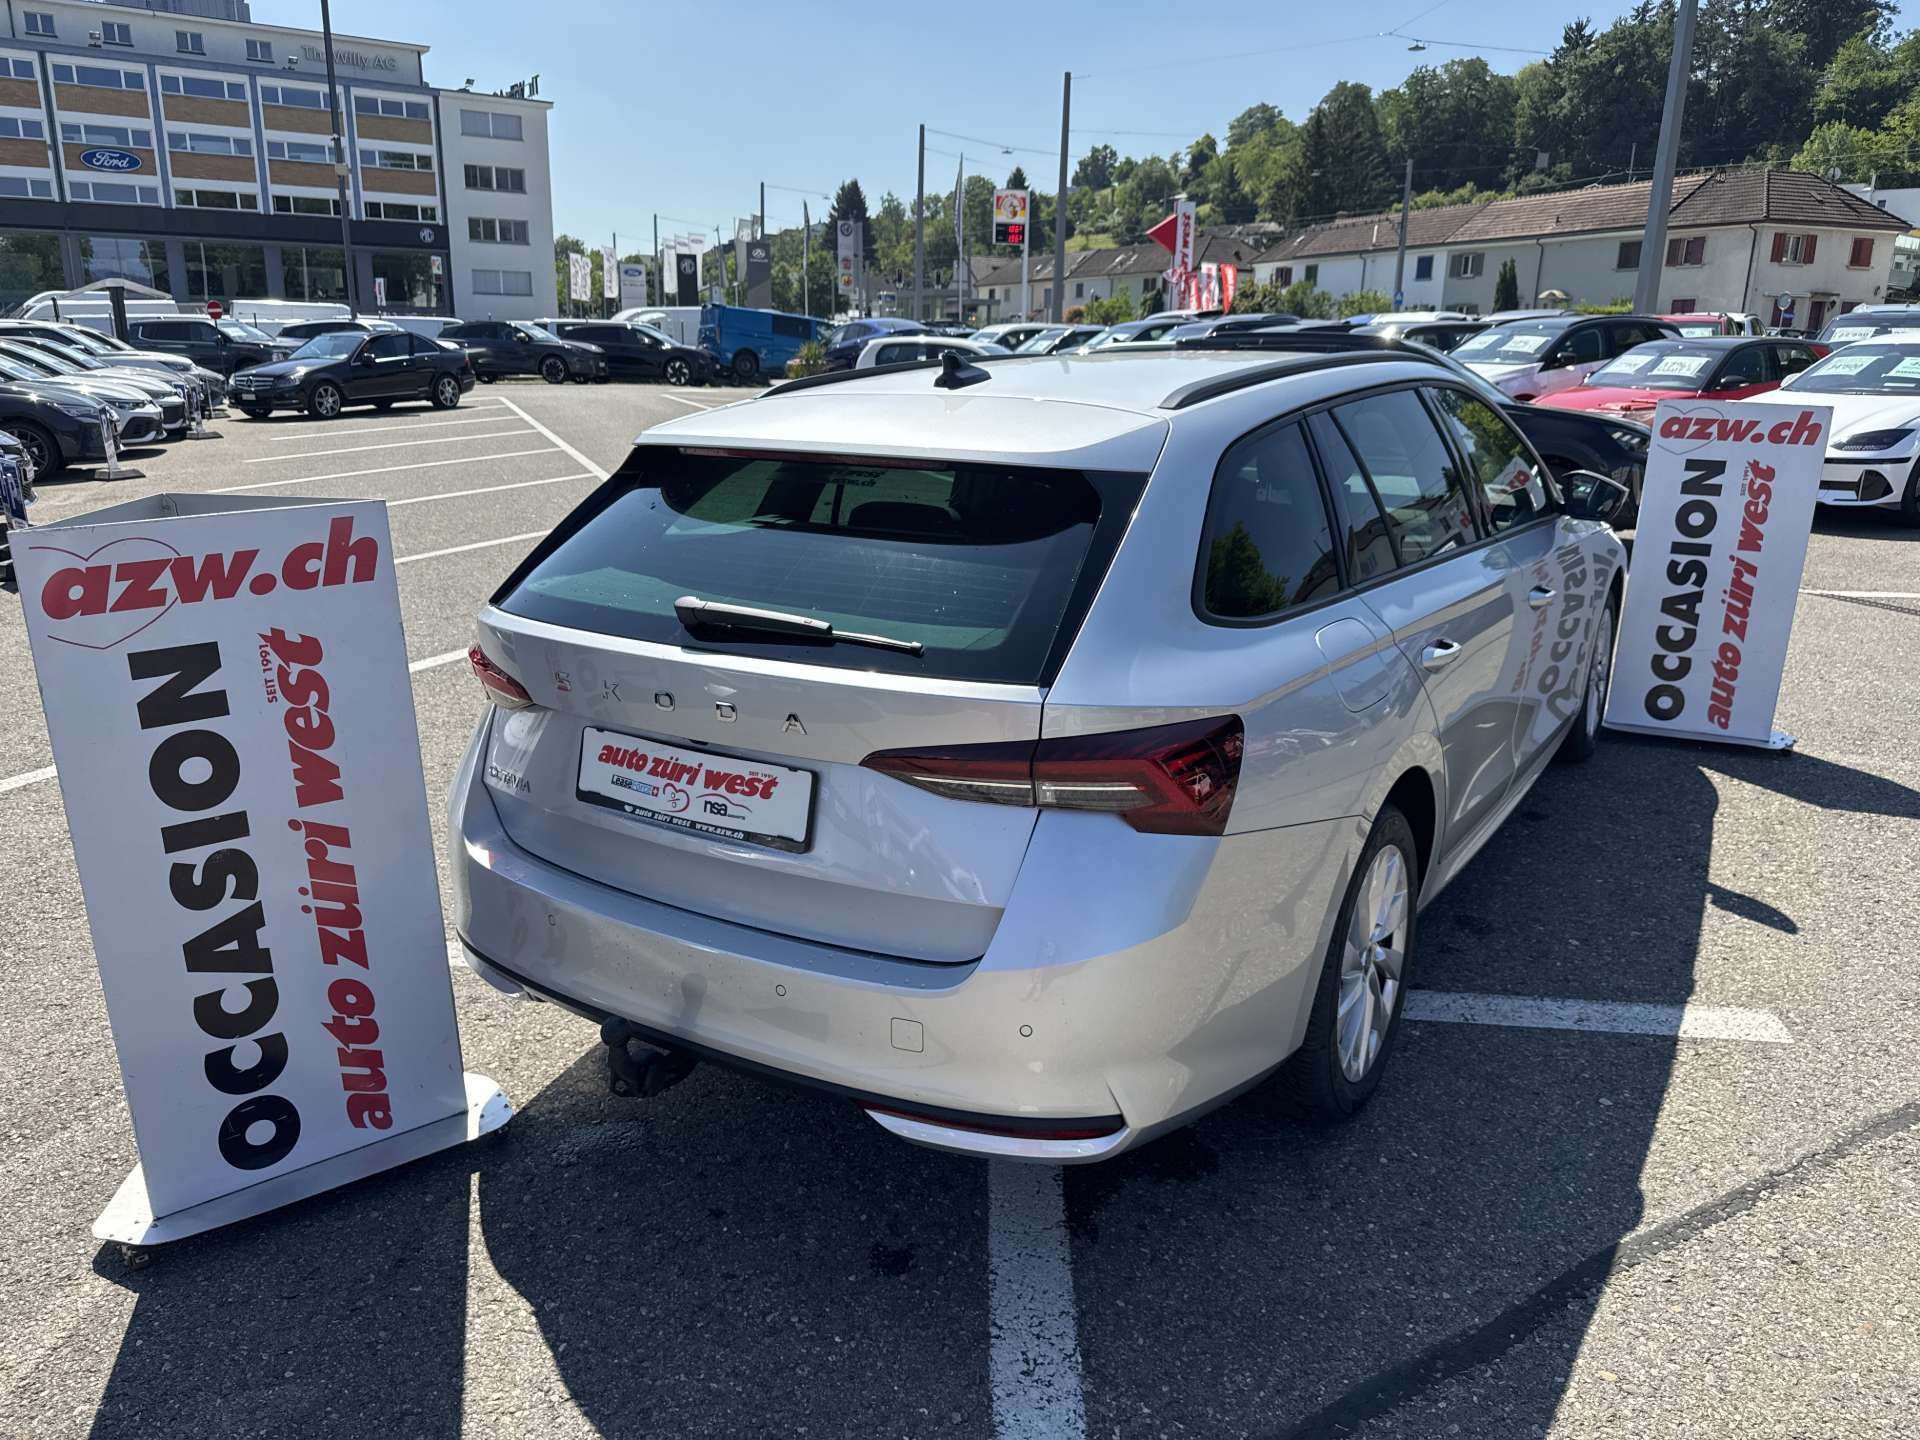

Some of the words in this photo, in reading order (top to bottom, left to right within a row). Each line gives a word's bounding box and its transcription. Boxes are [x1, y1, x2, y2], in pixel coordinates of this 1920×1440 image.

[332, 47, 369, 72] Willy
[374, 56, 397, 71] AG
[1660, 411, 1822, 445] azw.ch
[1737, 459, 1776, 552] west
[41, 516, 379, 620] azw.ch
[1645, 459, 1727, 721] OCCASION
[1721, 555, 1758, 643] züri
[258, 643, 273, 674] 1991
[264, 678, 278, 704] SEIT
[1708, 643, 1742, 730] auto
[257, 627, 344, 808] west
[598, 744, 648, 772] auto
[647, 755, 704, 786] züri
[703, 769, 779, 800] west
[703, 800, 728, 817] nsa
[634, 808, 652, 818] auto
[672, 817, 691, 827] west
[695, 822, 744, 840] www.azw.ch
[128, 641, 300, 1170] OCCASION
[288, 819, 369, 970] züri
[321, 978, 393, 1130] auto
